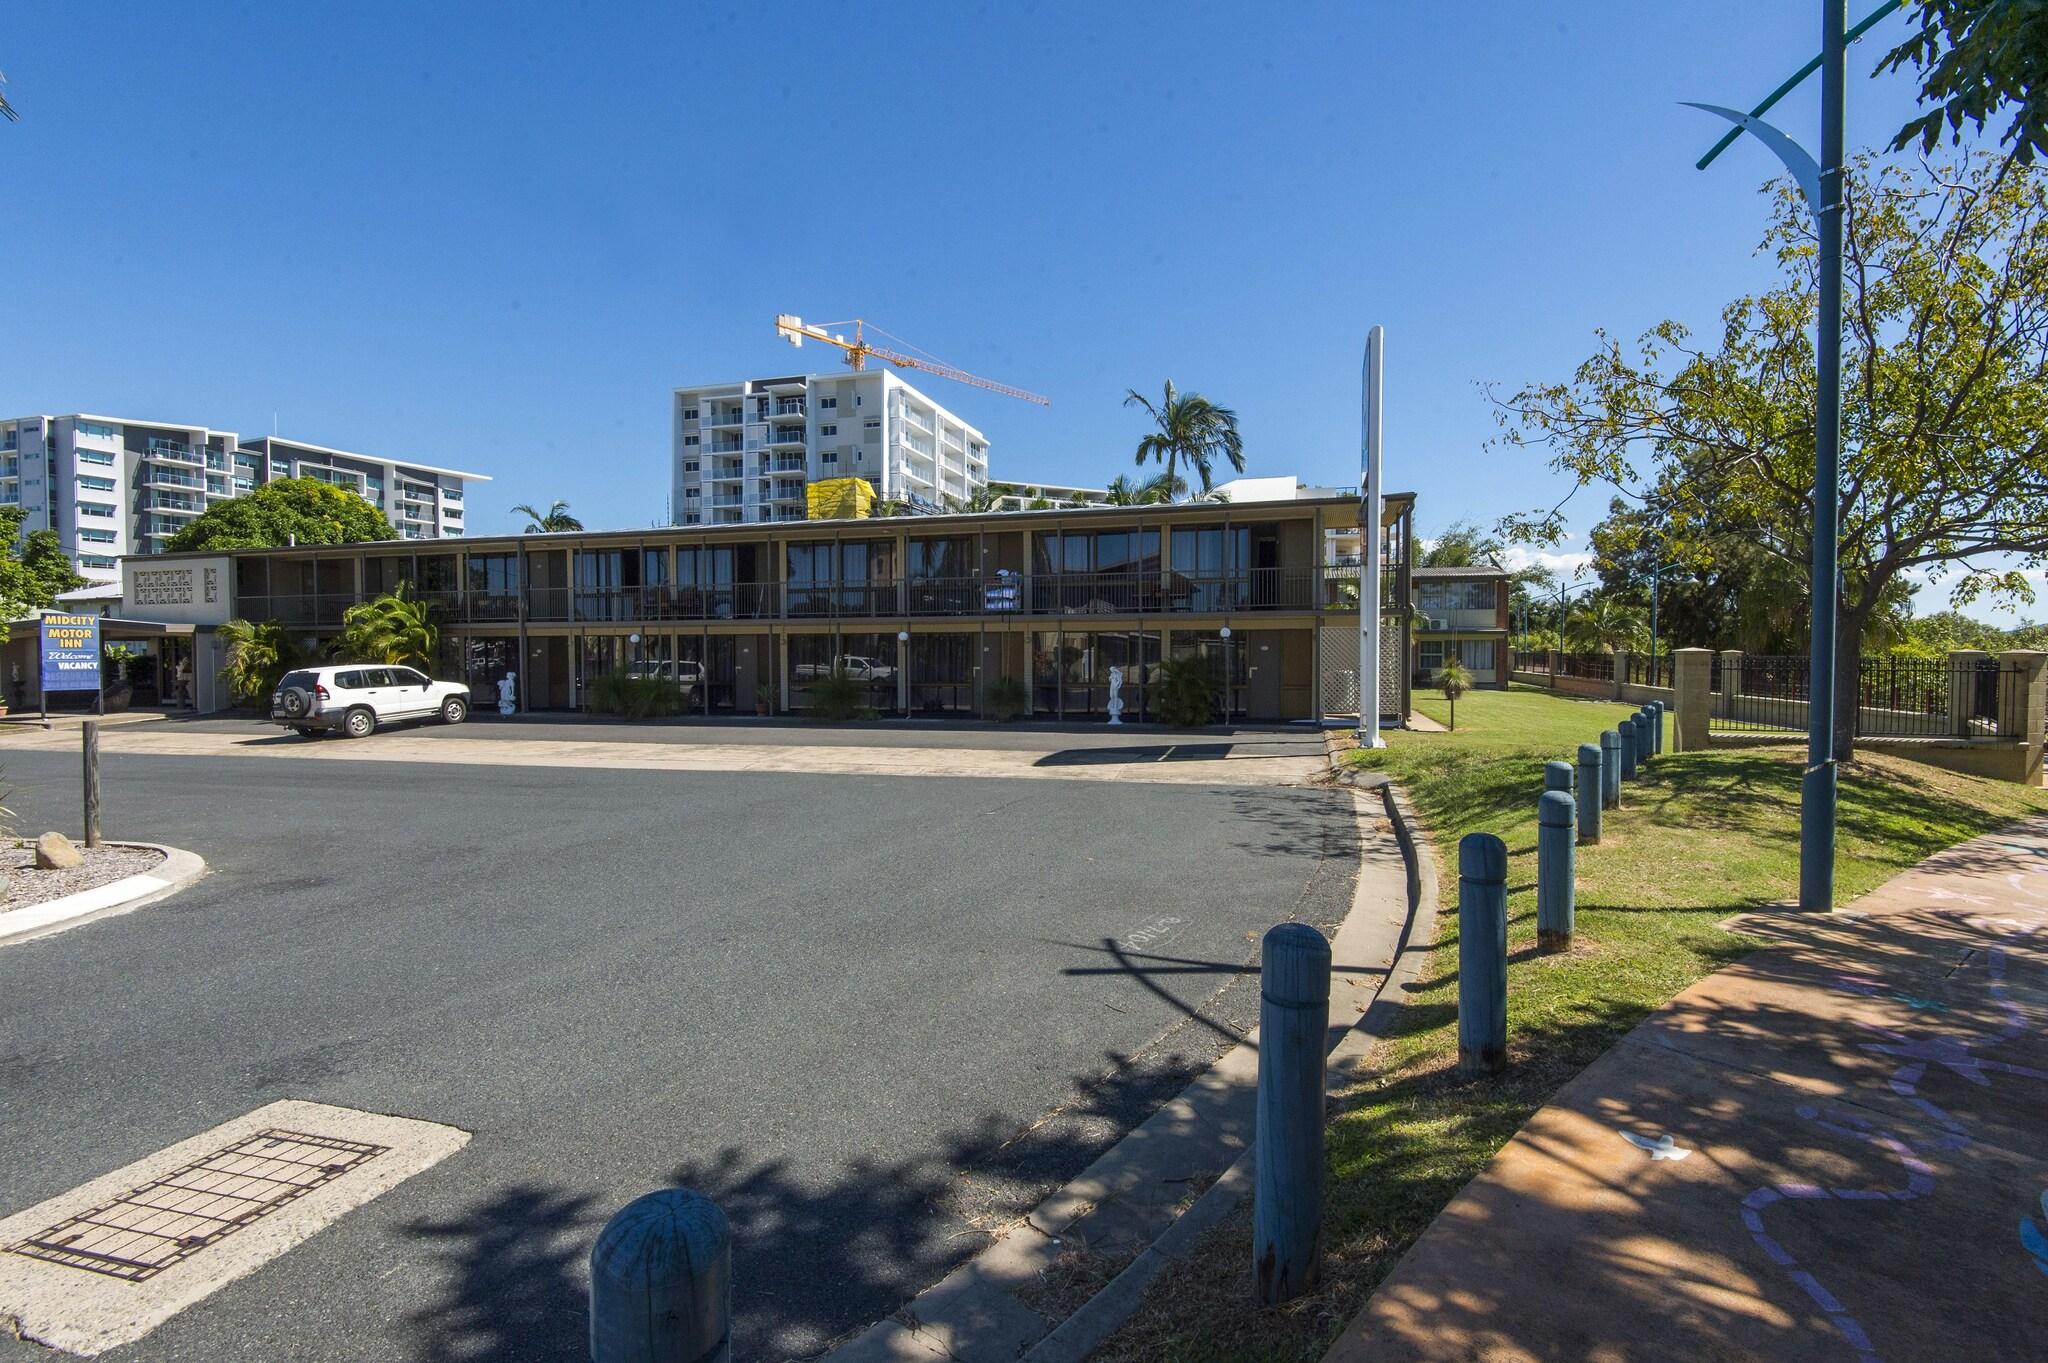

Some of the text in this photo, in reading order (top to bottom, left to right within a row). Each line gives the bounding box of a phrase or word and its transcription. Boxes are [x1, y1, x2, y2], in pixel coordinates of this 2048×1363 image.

[45, 615, 95, 625] MIDCITY
[48, 629, 93, 638] MOTOR
[59, 639, 83, 648] INN
[48, 652, 94, 660] Welcome
[58, 662, 98, 670] VACANCY
